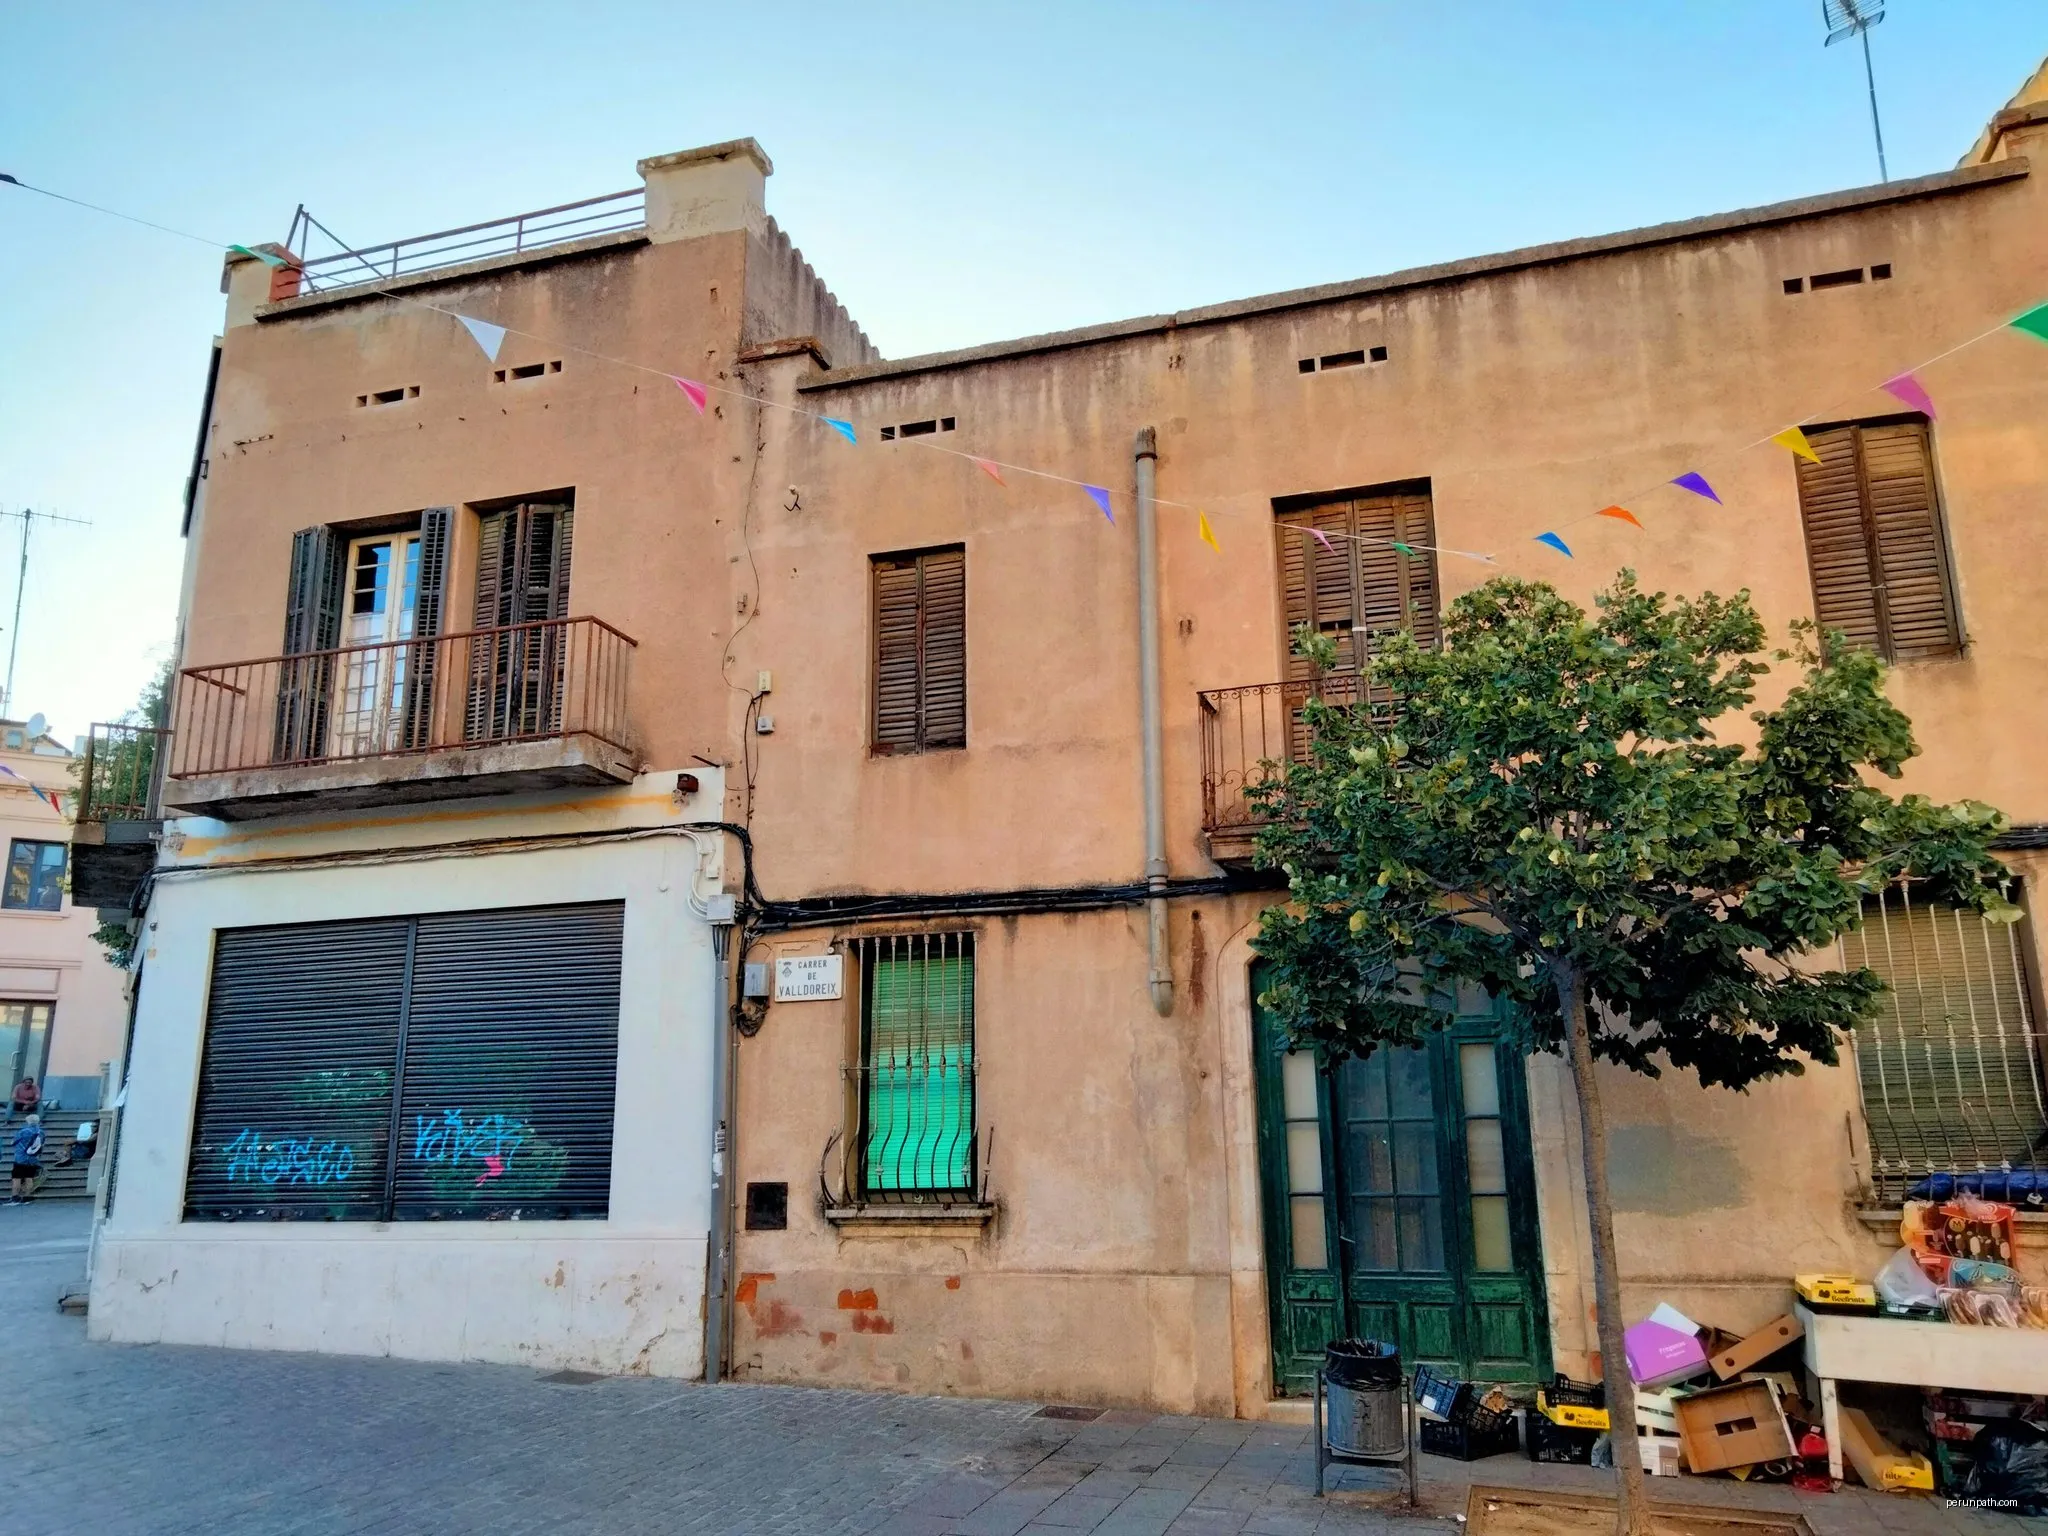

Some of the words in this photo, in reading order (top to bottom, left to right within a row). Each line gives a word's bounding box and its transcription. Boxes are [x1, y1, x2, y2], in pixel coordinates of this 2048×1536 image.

[798, 960, 827, 969] CARRER
[807, 972, 816, 980] DE
[779, 983, 836, 997] VALLDOREIX
